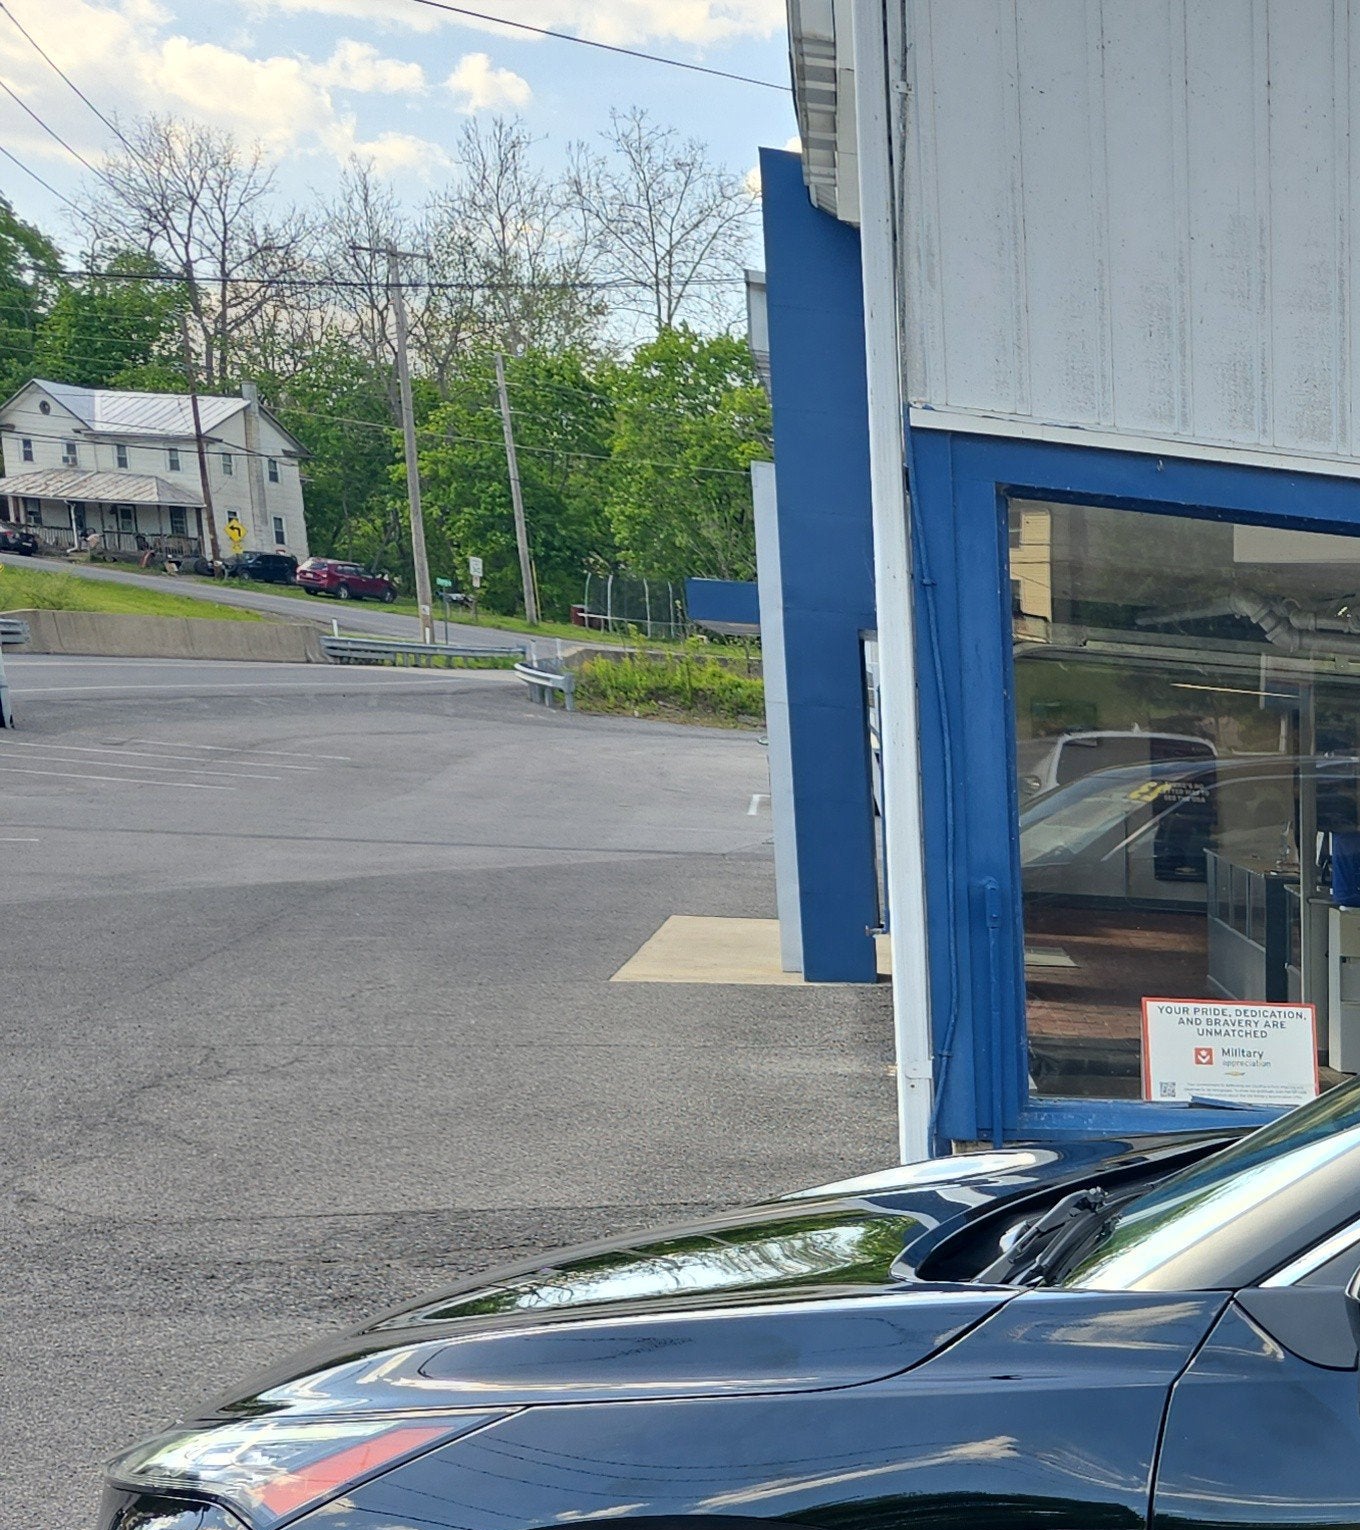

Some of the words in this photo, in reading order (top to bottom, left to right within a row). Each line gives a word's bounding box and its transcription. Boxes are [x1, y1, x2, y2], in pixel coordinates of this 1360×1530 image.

[1157, 1005, 1190, 1015] YOUR
[1193, 1007, 1232, 1018] PRIDE,
[1235, 1008, 1307, 1021] DEDICATION,
[1178, 1017, 1202, 1026] AND
[1206, 1018, 1260, 1028] BRAVERY
[1264, 1020, 1287, 1029] ARE
[1197, 1028, 1268, 1039] UNMATCHED
[1221, 1047, 1264, 1060] Military
